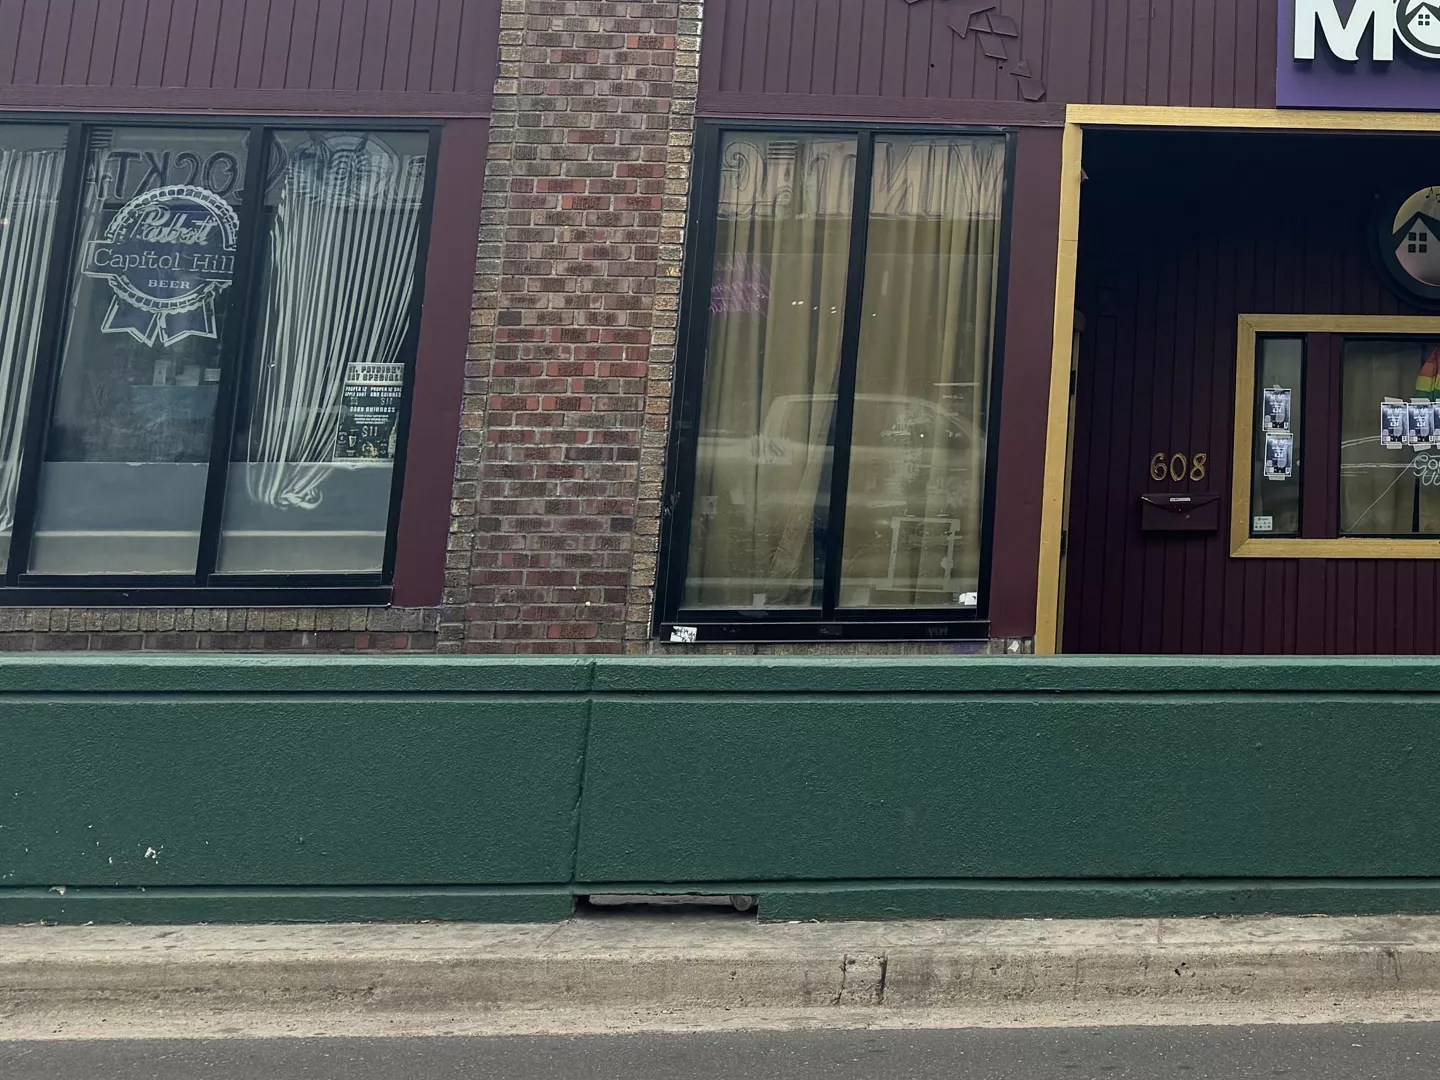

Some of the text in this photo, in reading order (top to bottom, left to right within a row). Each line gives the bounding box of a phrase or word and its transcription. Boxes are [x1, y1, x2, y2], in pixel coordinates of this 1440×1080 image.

[93, 248, 181, 277] Capitol
[148, 279, 191, 290] BEER
[1150, 452, 1207, 482] 608
